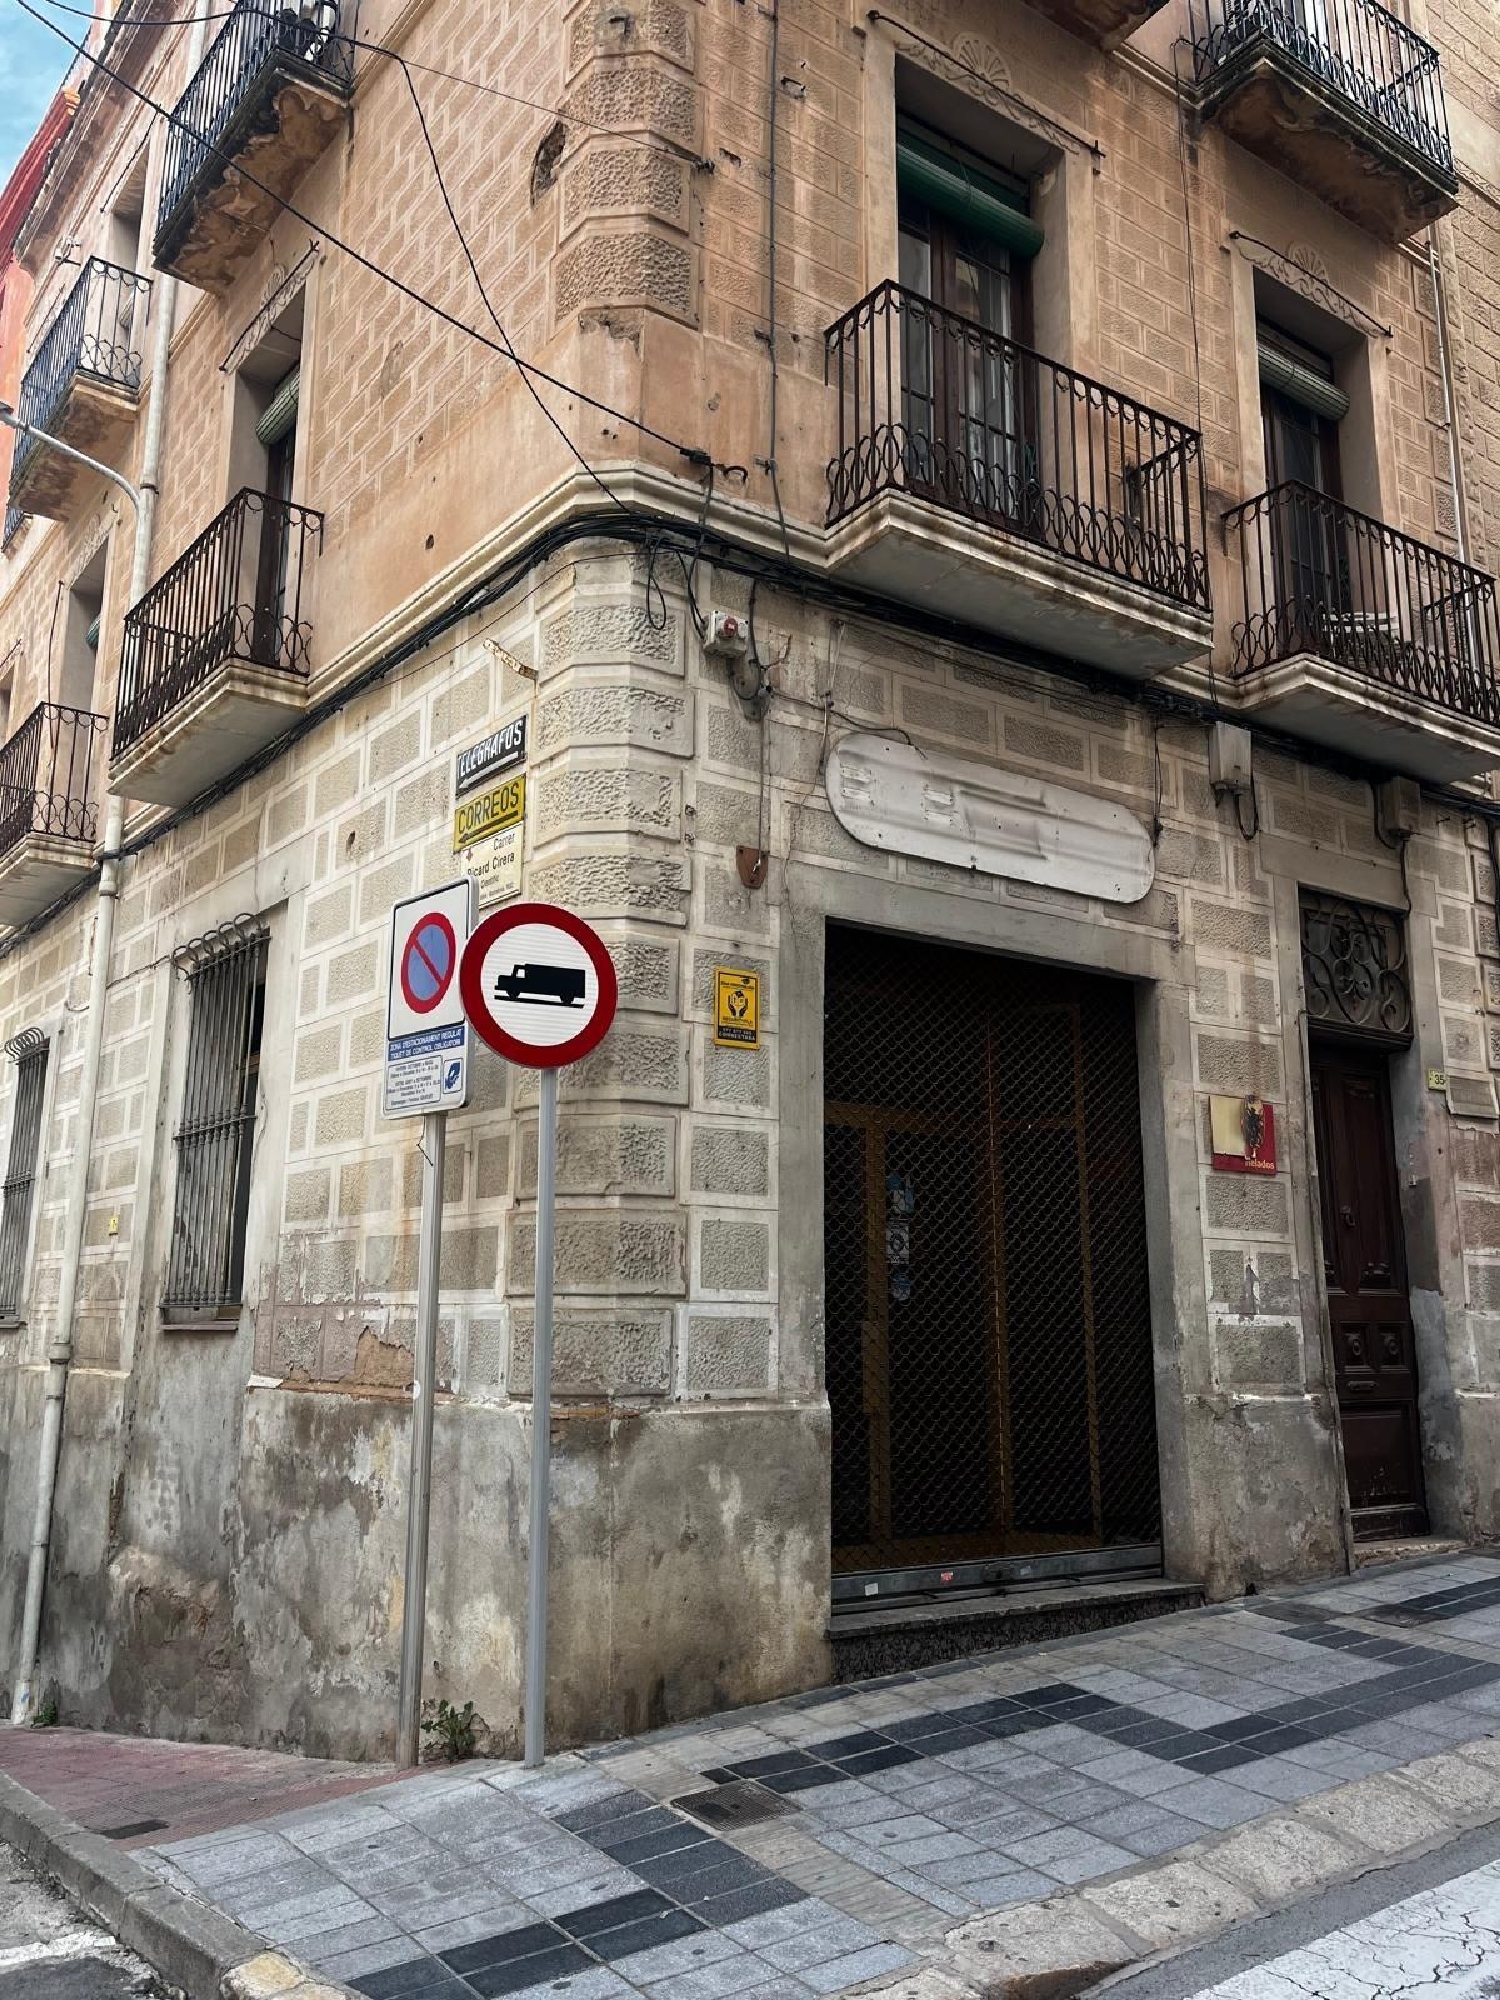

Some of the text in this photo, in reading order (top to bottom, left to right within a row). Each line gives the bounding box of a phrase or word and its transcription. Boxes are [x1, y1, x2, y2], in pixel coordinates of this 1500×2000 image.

[458, 782, 519, 834] CORREOS
[493, 833, 515, 850] Carrer
[492, 852, 515, 870] Cirera
[1434, 1074, 1446, 1085] 35
